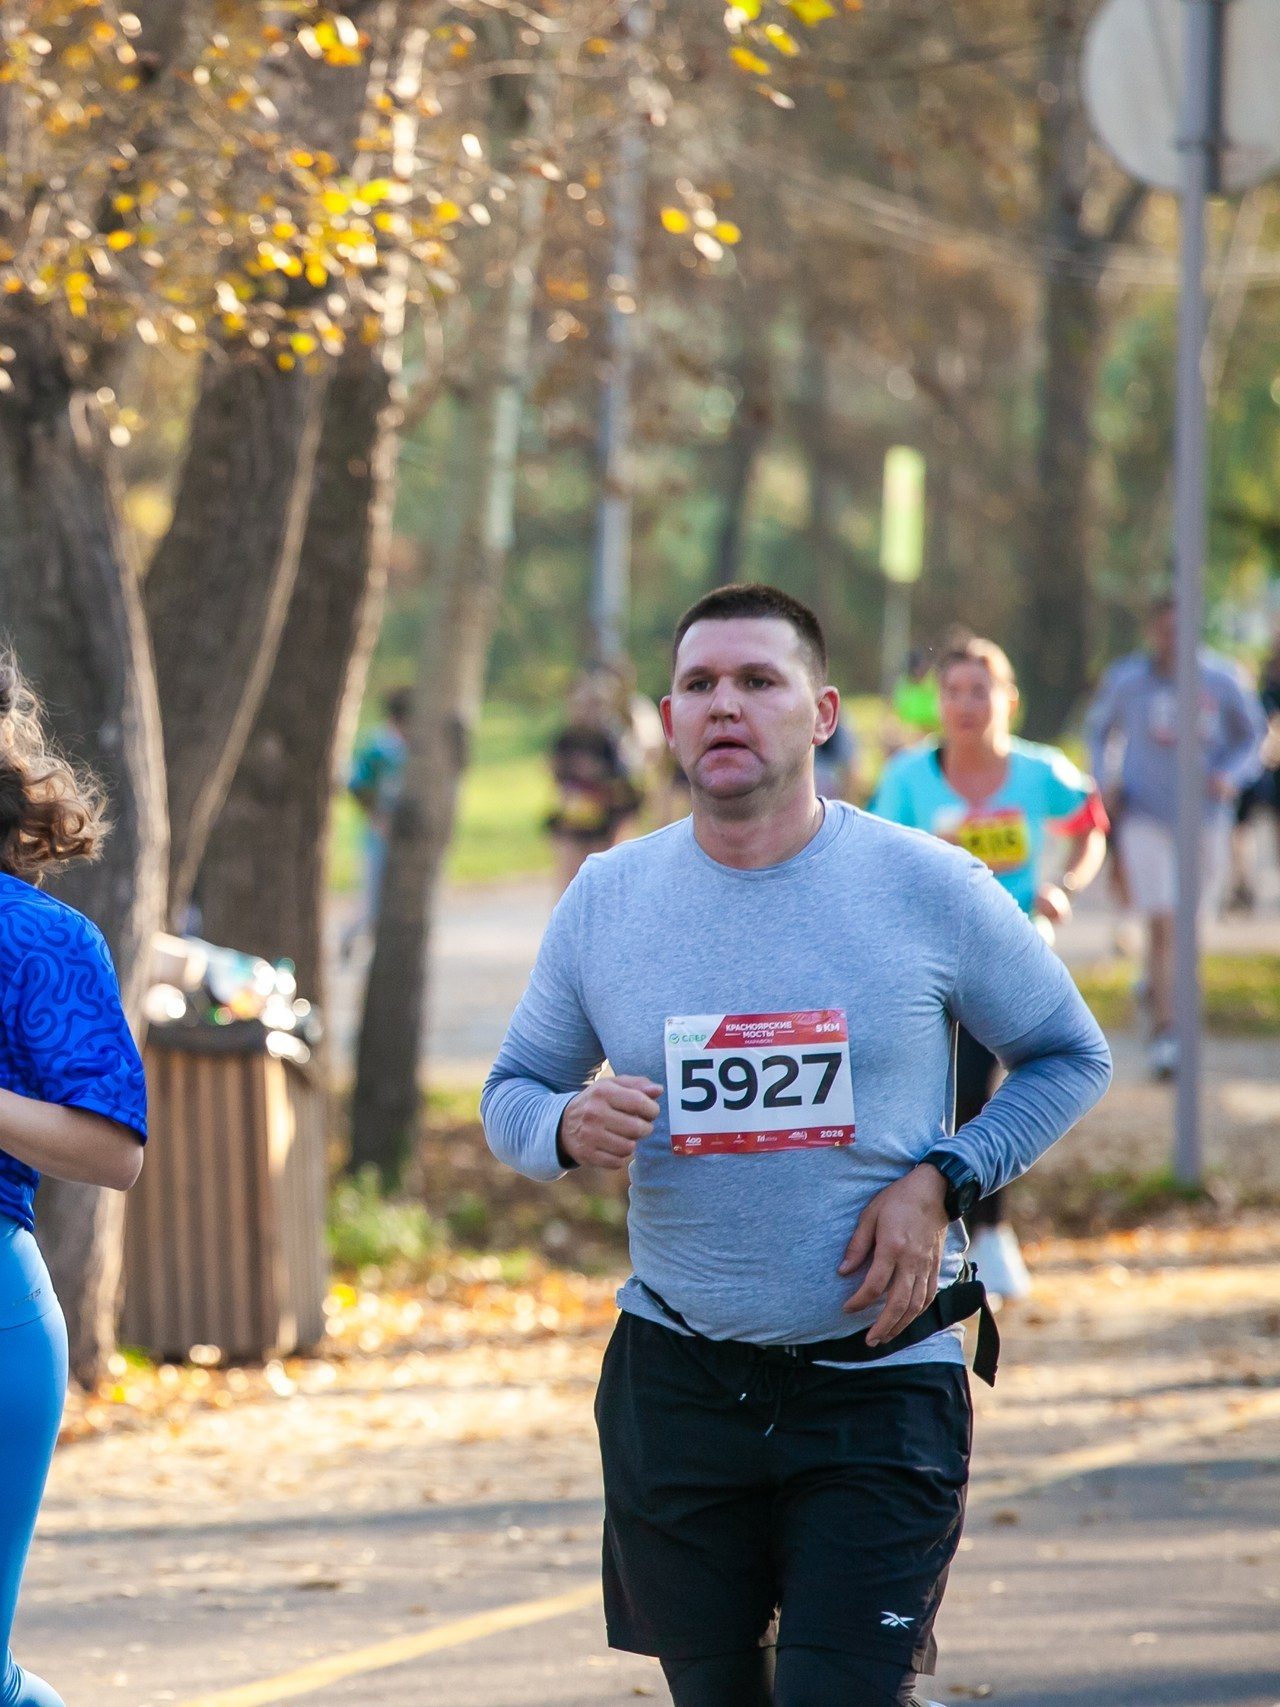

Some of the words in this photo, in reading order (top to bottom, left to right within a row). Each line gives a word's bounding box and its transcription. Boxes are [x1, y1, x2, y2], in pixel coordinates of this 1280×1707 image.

[725, 1021, 793, 1031] КРАСНОЯРСКИЕ
[742, 1030, 774, 1039] МОСТЫ
[681, 1052, 842, 1112] 5927
[820, 1130, 844, 1138] 2026
